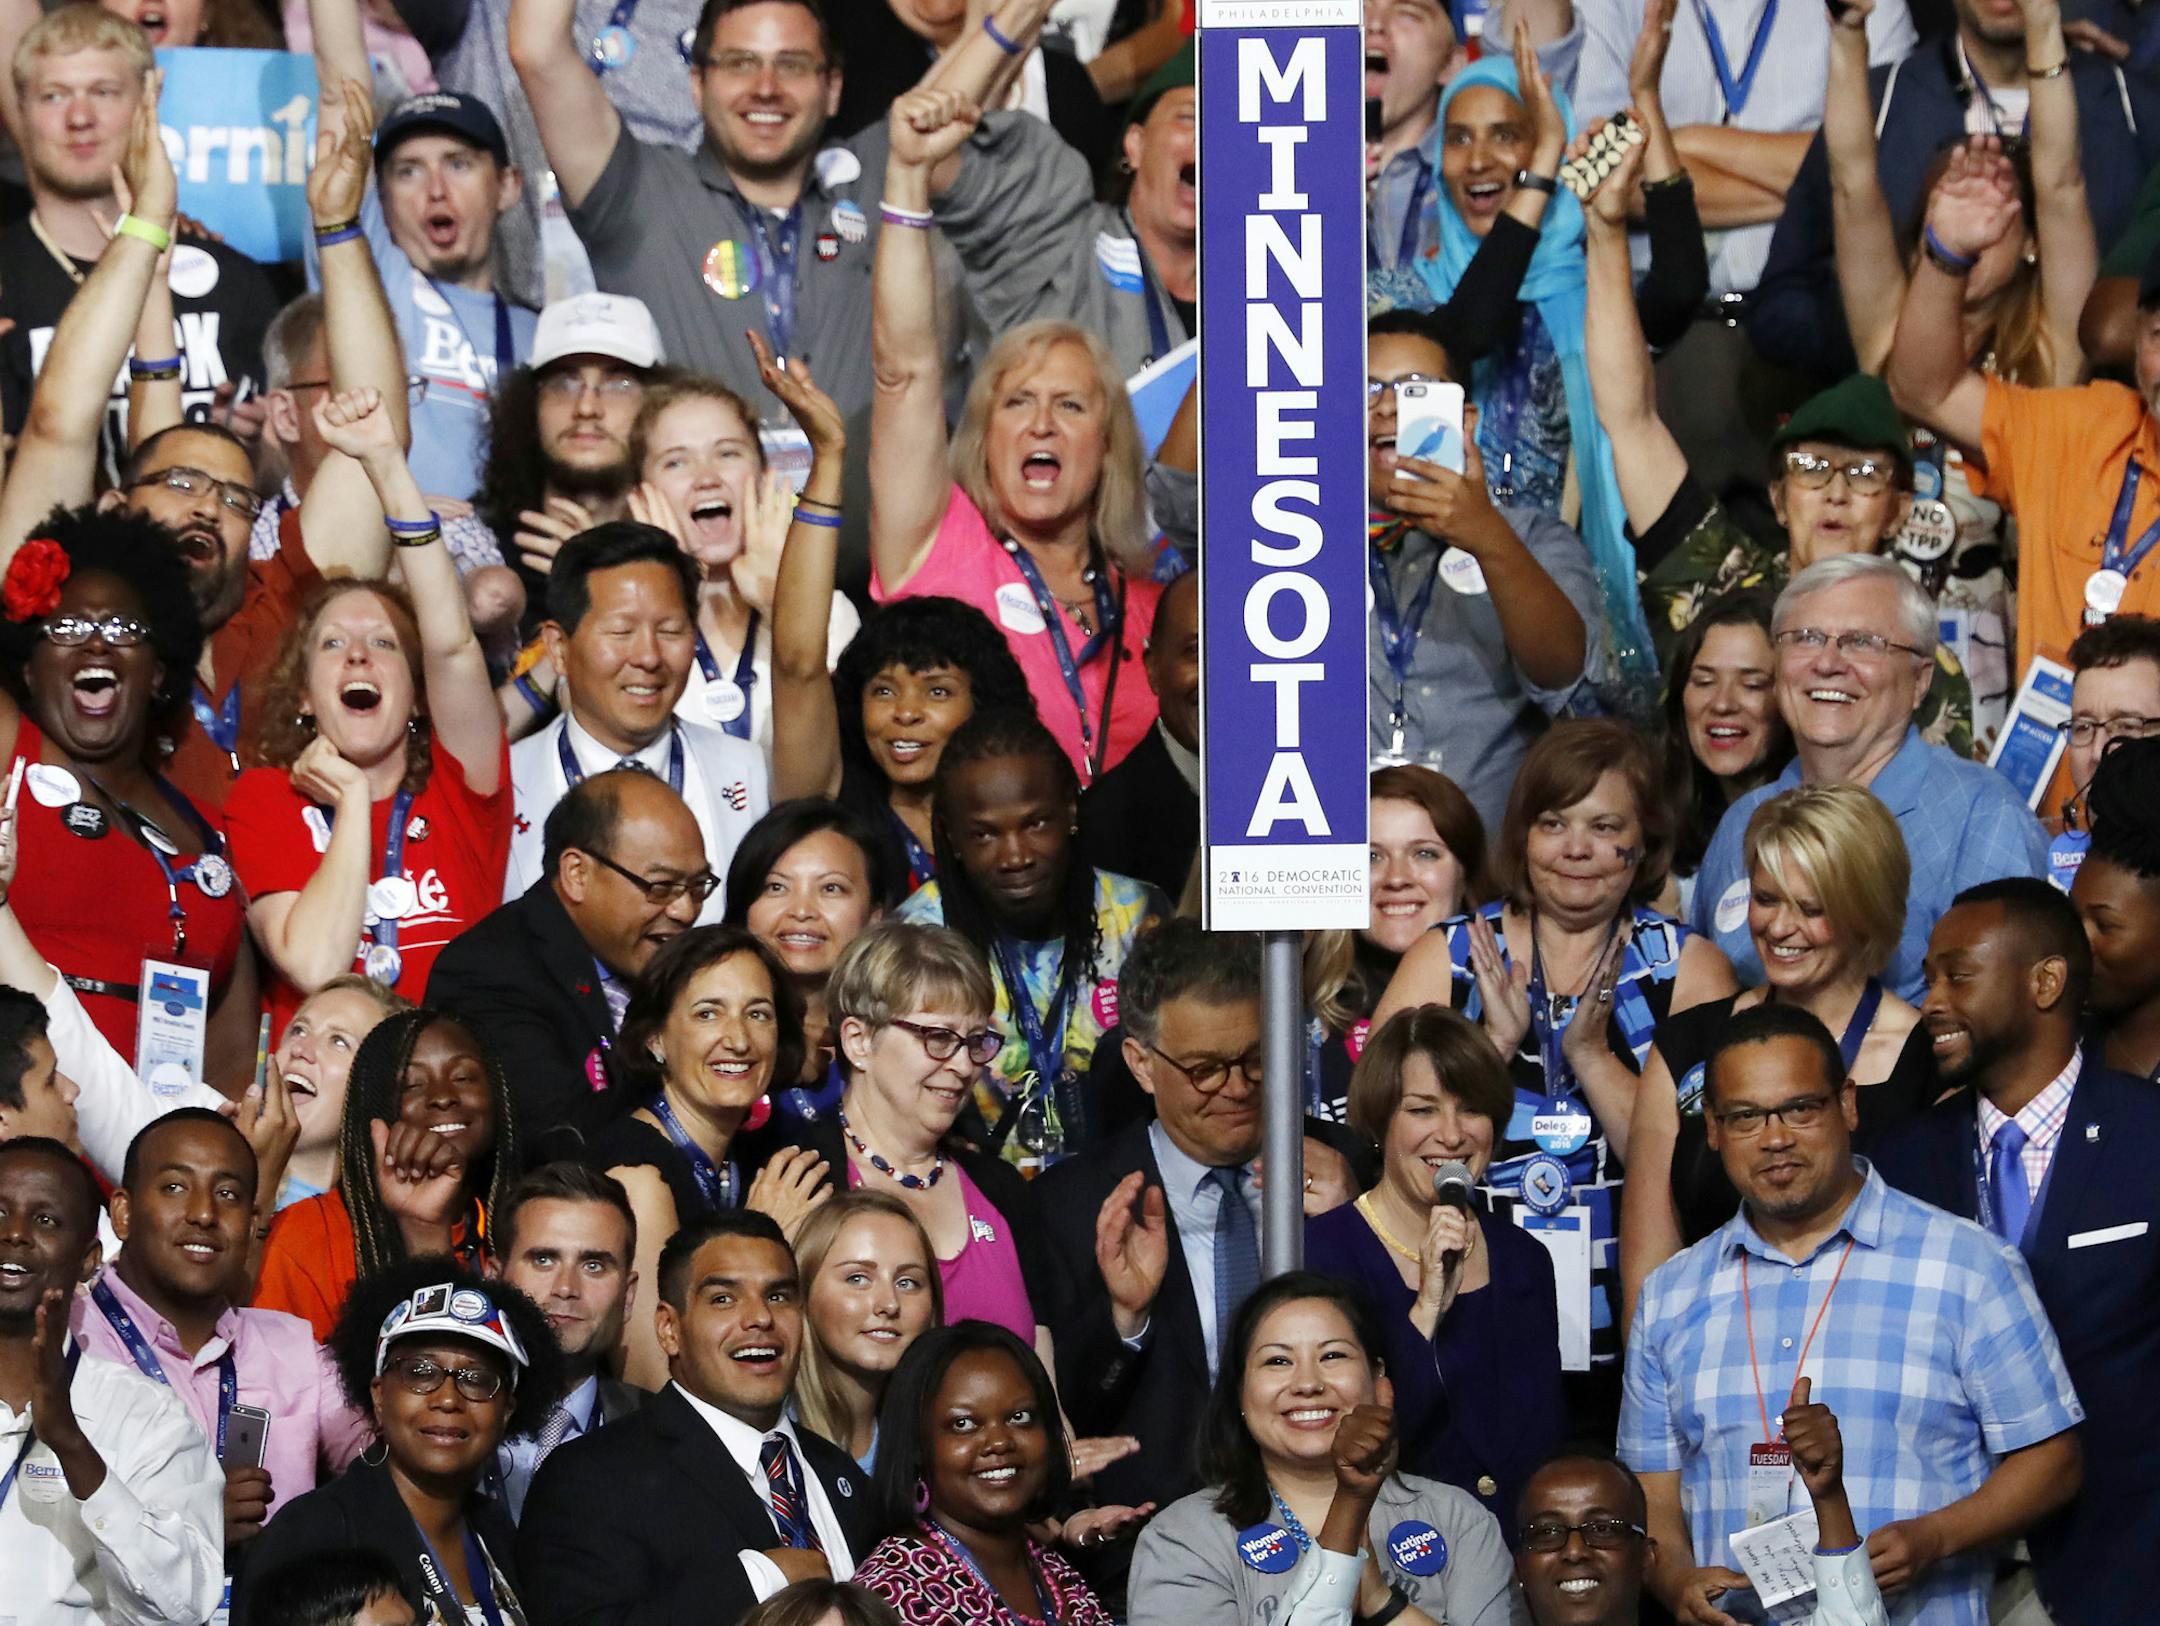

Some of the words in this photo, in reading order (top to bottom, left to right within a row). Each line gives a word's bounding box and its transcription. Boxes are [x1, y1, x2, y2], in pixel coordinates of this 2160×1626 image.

[1218, 8, 1345, 19] PHILADELPHIA
[1237, 37, 1333, 838] MINNESOTA
[1913, 505, 1945, 525] NO
[1909, 531, 1942, 550] TPP
[1267, 869, 1362, 883] DEMOCRATIC
[1218, 885, 1277, 896] NATIONAL
[1283, 883, 1363, 895] CONVENTION
[1751, 1453, 1790, 1466] TUESDAY
[24, 1462, 65, 1477] Bern
[1241, 1528, 1288, 1554] Women
[1391, 1529, 1439, 1554] Latinos
[1250, 1548, 1269, 1564] for
[1398, 1548, 1418, 1565] for
[418, 1553, 444, 1595] Canon
